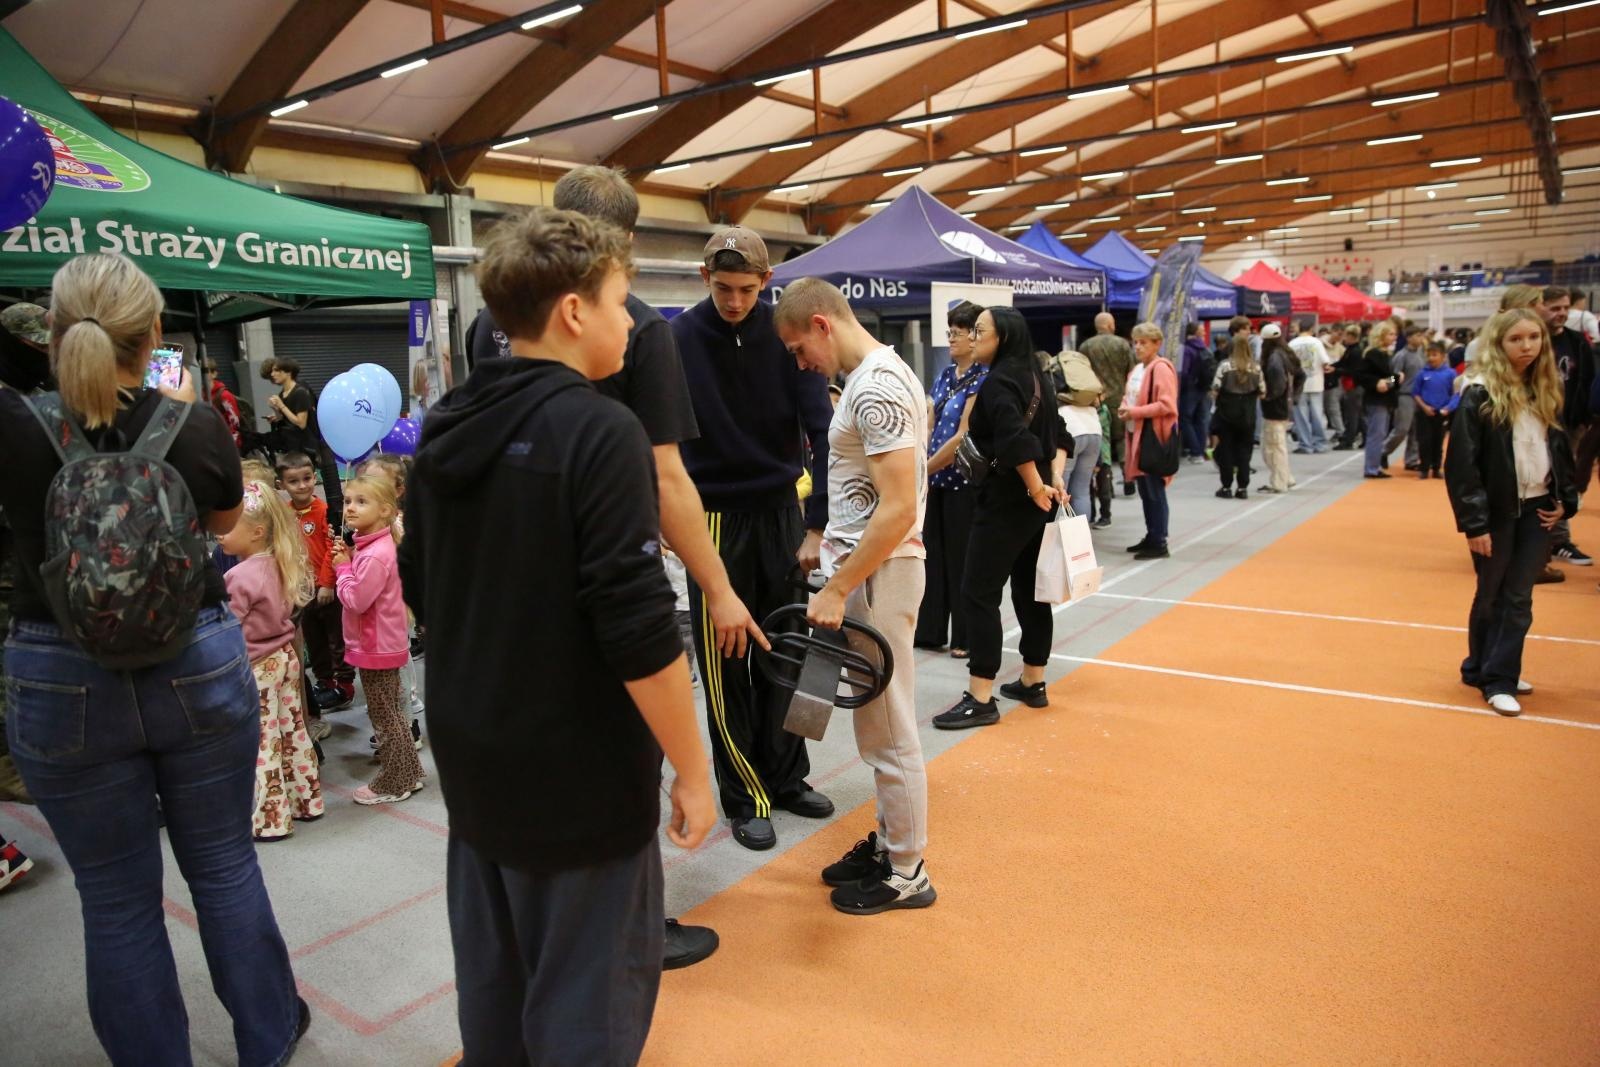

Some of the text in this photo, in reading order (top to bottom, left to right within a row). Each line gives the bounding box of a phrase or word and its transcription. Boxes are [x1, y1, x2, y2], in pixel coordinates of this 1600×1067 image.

[96, 219, 226, 270] Straży
[235, 231, 413, 280] Granicznej
[840, 277, 909, 299] do Nas
